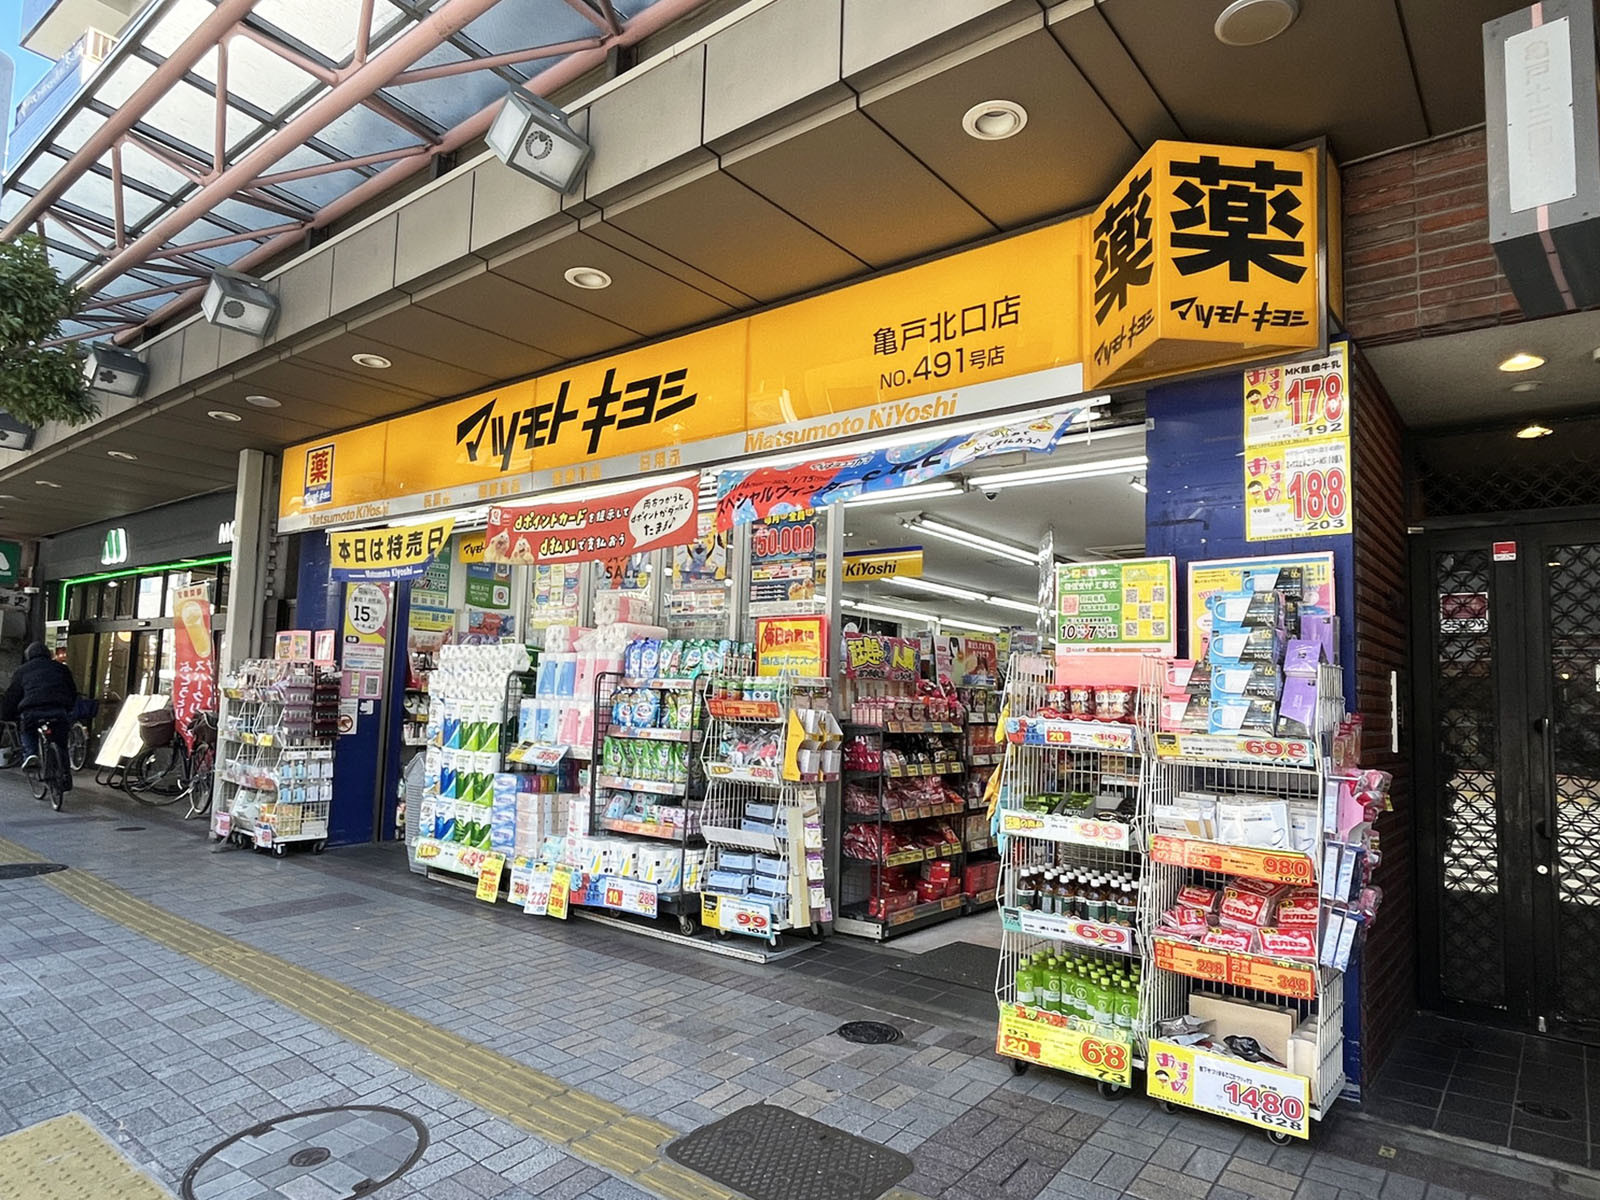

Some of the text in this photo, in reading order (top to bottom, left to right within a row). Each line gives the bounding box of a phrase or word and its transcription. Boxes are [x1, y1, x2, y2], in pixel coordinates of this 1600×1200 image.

[1170, 155, 1308, 284] 薬
[1093, 166, 1154, 327] 薬
[873, 294, 1020, 356] 亀戸北口店
[1170, 297, 1309, 332] マツモトキヨシ
[1094, 309, 1155, 366] マツモトキヨシ
[1286, 373, 1344, 425] 178
[456, 367, 698, 470] マツモトキヨシ
[745, 414, 864, 453] Matsumoto
[1304, 423, 1342, 435] 192
[310, 450, 329, 484] 薬
[1288, 467, 1346, 521] 188
[1307, 519, 1345, 531] 203
[338, 526, 444, 564] 本日は特売日
[845, 560, 897, 577] KiYoshi
[1080, 822, 1124, 841] 99
[1263, 857, 1310, 876] 980
[736, 912, 768, 928] 99
[1075, 923, 1126, 944] 69
[1008, 1038, 1030, 1054] 20
[1080, 1036, 1128, 1072] 68
[1094, 1068, 1126, 1083] 73
[1224, 1081, 1304, 1121] 1480
[1250, 1112, 1302, 1132] 1628
